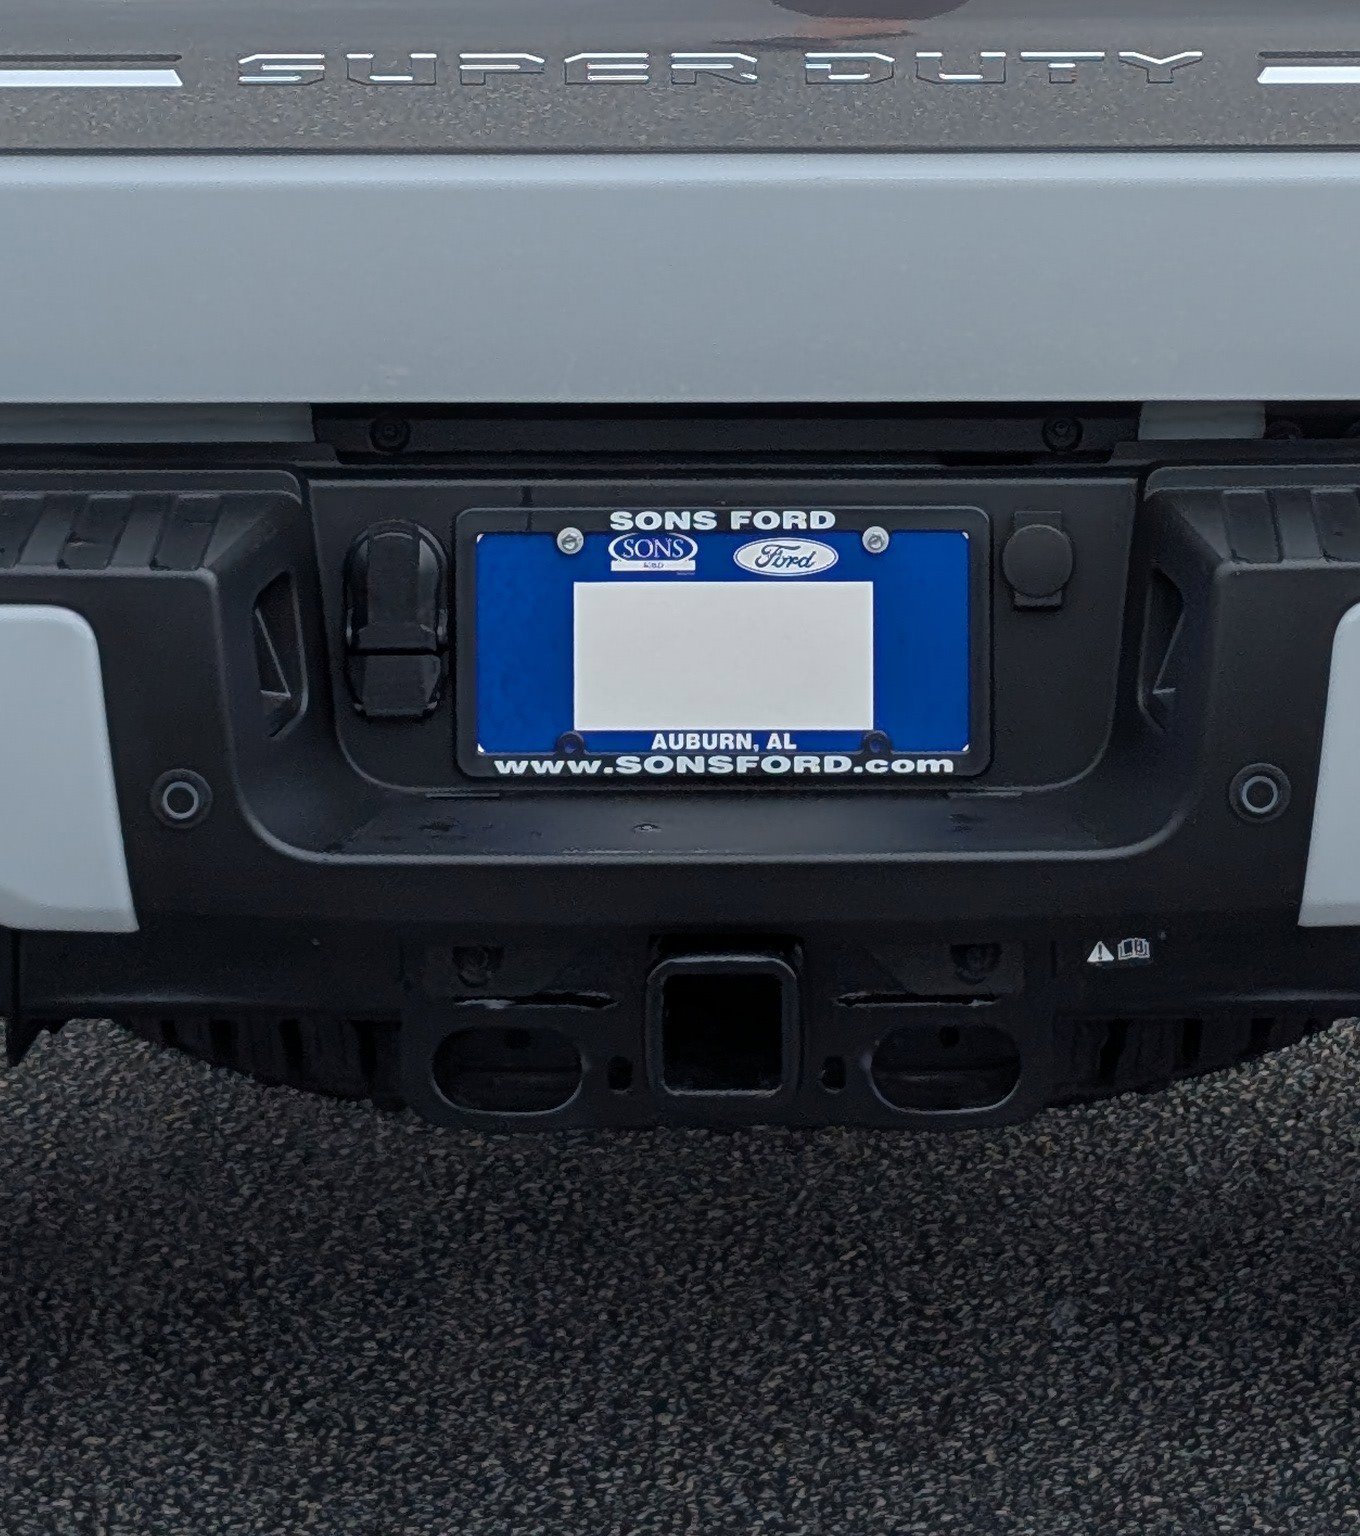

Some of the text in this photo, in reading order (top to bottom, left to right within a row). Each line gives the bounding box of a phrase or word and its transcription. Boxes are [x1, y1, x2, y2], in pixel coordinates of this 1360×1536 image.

[609, 510, 837, 531] SONS FORD
[622, 538, 684, 559] SONS
[754, 544, 816, 569] Ford
[651, 733, 797, 752] AUBURN, AL
[494, 755, 955, 775] www.SONSFORD.com
